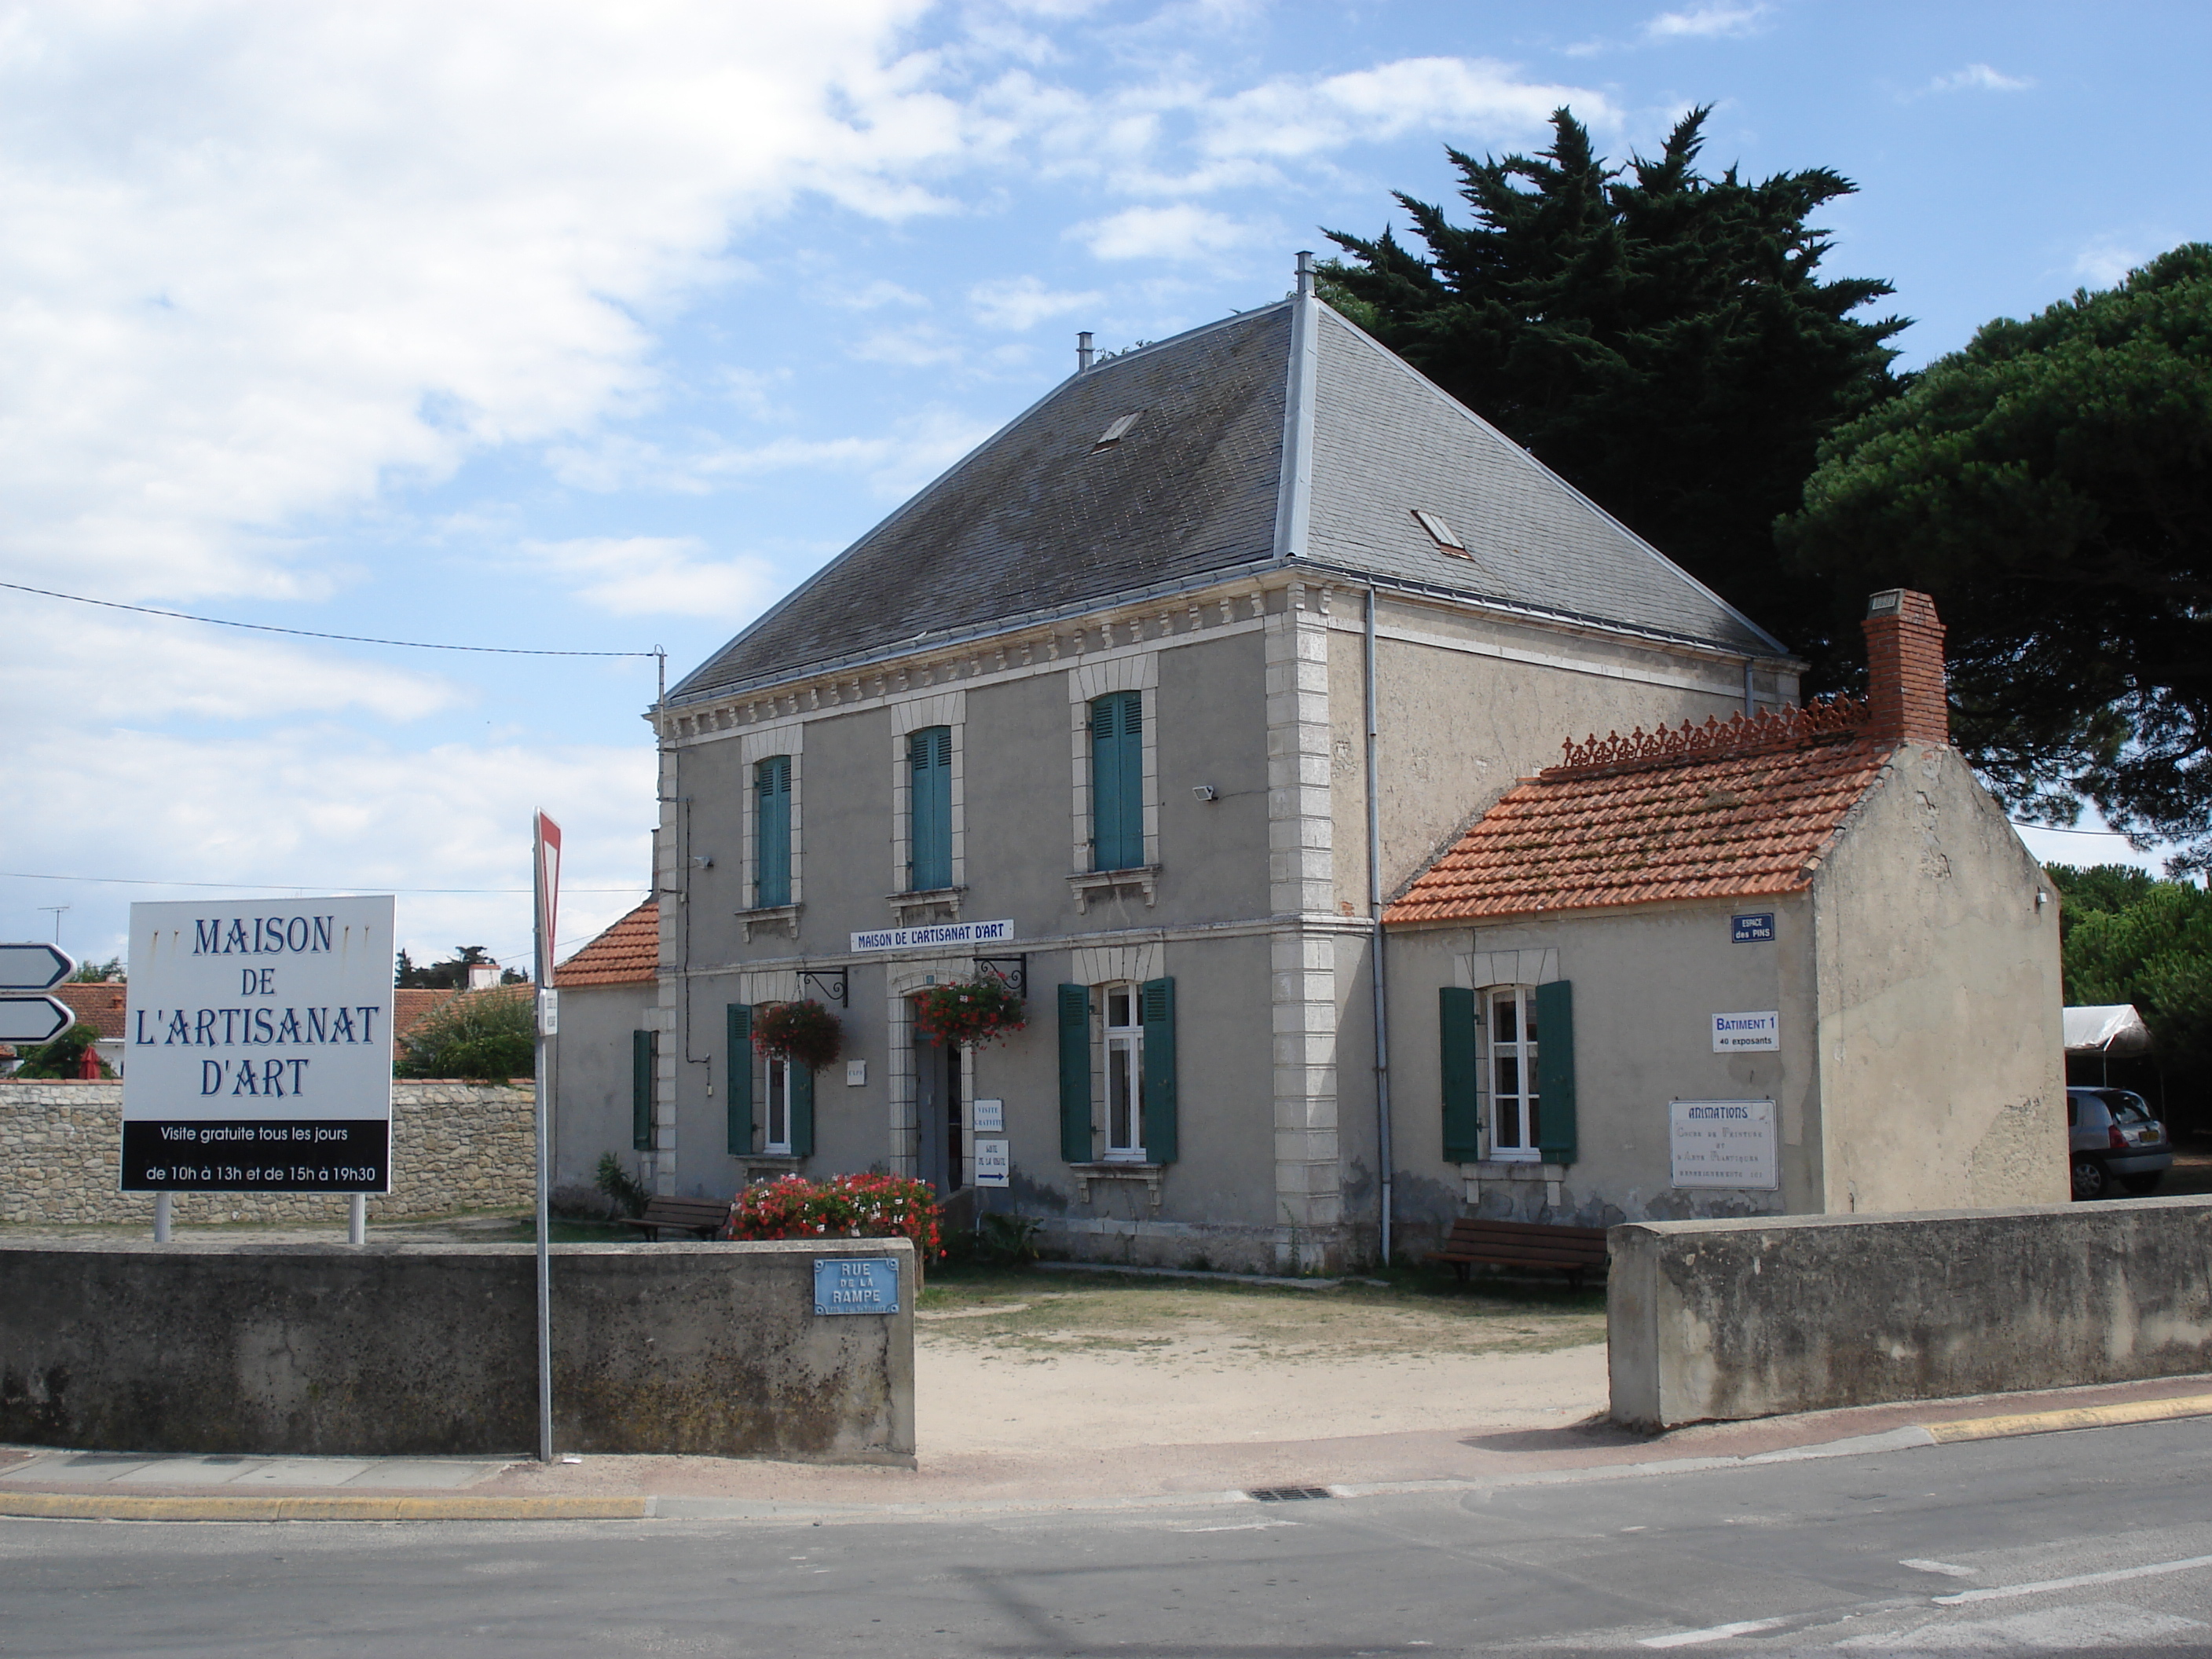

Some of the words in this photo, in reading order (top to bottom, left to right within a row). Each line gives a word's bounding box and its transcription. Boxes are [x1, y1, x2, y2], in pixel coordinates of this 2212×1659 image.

[1741, 918, 1763, 928] ESPACE
[192, 916, 335, 956] MAISON
[859, 934, 892, 949] MAISON
[895, 932, 907, 946] DE
[911, 926, 971, 944] L'ARTISANAT
[976, 923, 1005, 939] D'ART
[1752, 928, 1771, 938] PINS
[240, 968, 276, 997] DE
[135, 1006, 381, 1049] L'ARTISANAT
[1716, 1017, 1766, 1031] BATIMENT
[1769, 1016, 1775, 1029] 1
[1732, 1036, 1772, 1046] exposants
[200, 1058, 309, 1099] D'ART
[1688, 1106, 1749, 1119] ANIMATIONS
[160, 1126, 196, 1141] Visite
[200, 1126, 255, 1144] gratuite
[258, 1126, 288, 1141] tous
[291, 1126, 311, 1141] les
[314, 1126, 348, 1143] jours
[146, 1166, 166, 1181] de
[171, 1166, 196, 1180] 10h
[200, 1166, 211, 1181] à
[217, 1166, 242, 1180] 13h
[246, 1166, 261, 1181] et
[264, 1166, 284, 1181] de
[289, 1166, 315, 1181] 15h
[318, 1166, 329, 1181] à
[333, 1166, 376, 1181] 19h30
[841, 1263, 871, 1276] RUE
[840, 1279, 855, 1287] DE
[859, 1277, 873, 1287] LA
[833, 1289, 881, 1303] RAMPE
